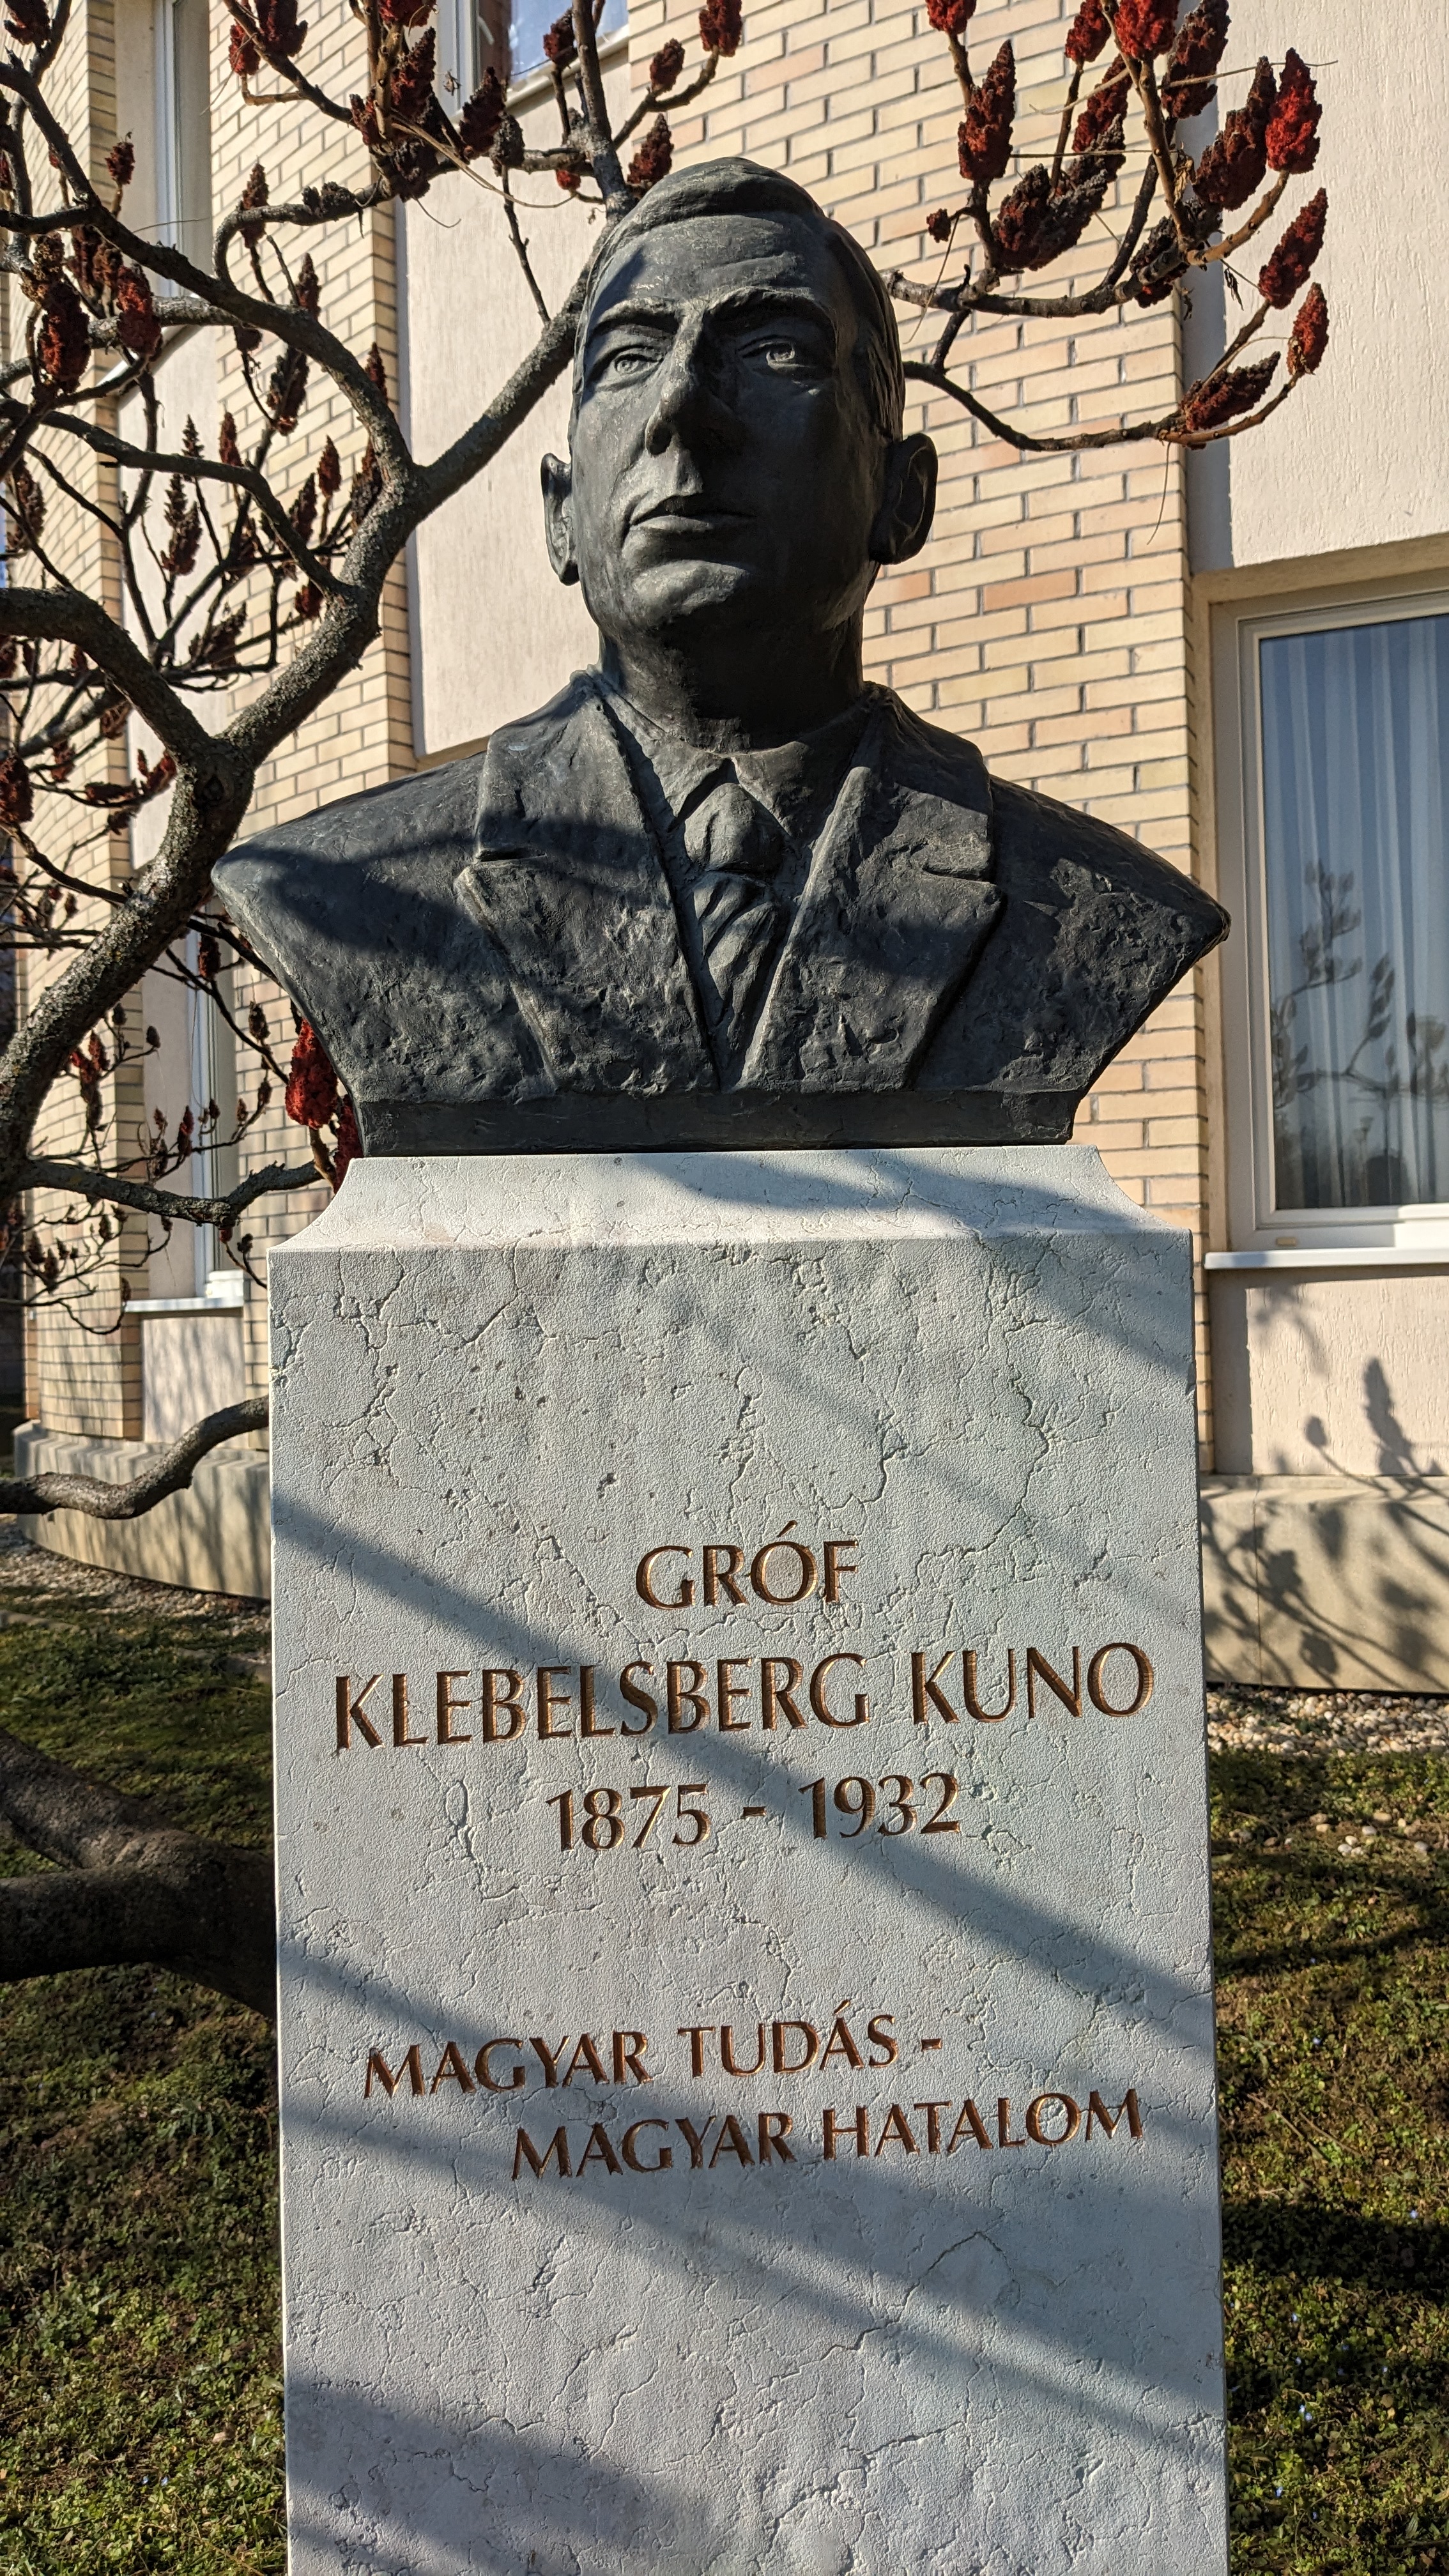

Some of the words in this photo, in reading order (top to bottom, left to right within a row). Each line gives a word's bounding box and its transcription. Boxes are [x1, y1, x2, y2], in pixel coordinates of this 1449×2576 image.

[635, 1520, 859, 1611] GRÓF
[336, 1653, 870, 1751] KLEBELSBERG
[912, 1643, 1154, 1726] KUNO
[548, 1783, 711, 1851] 1875
[799, 1772, 961, 1839] 1932
[364, 2030, 653, 2098] MAGYAR
[512, 2112, 794, 2180] MAGYAR
[822, 2089, 1143, 2161] HATALOM
